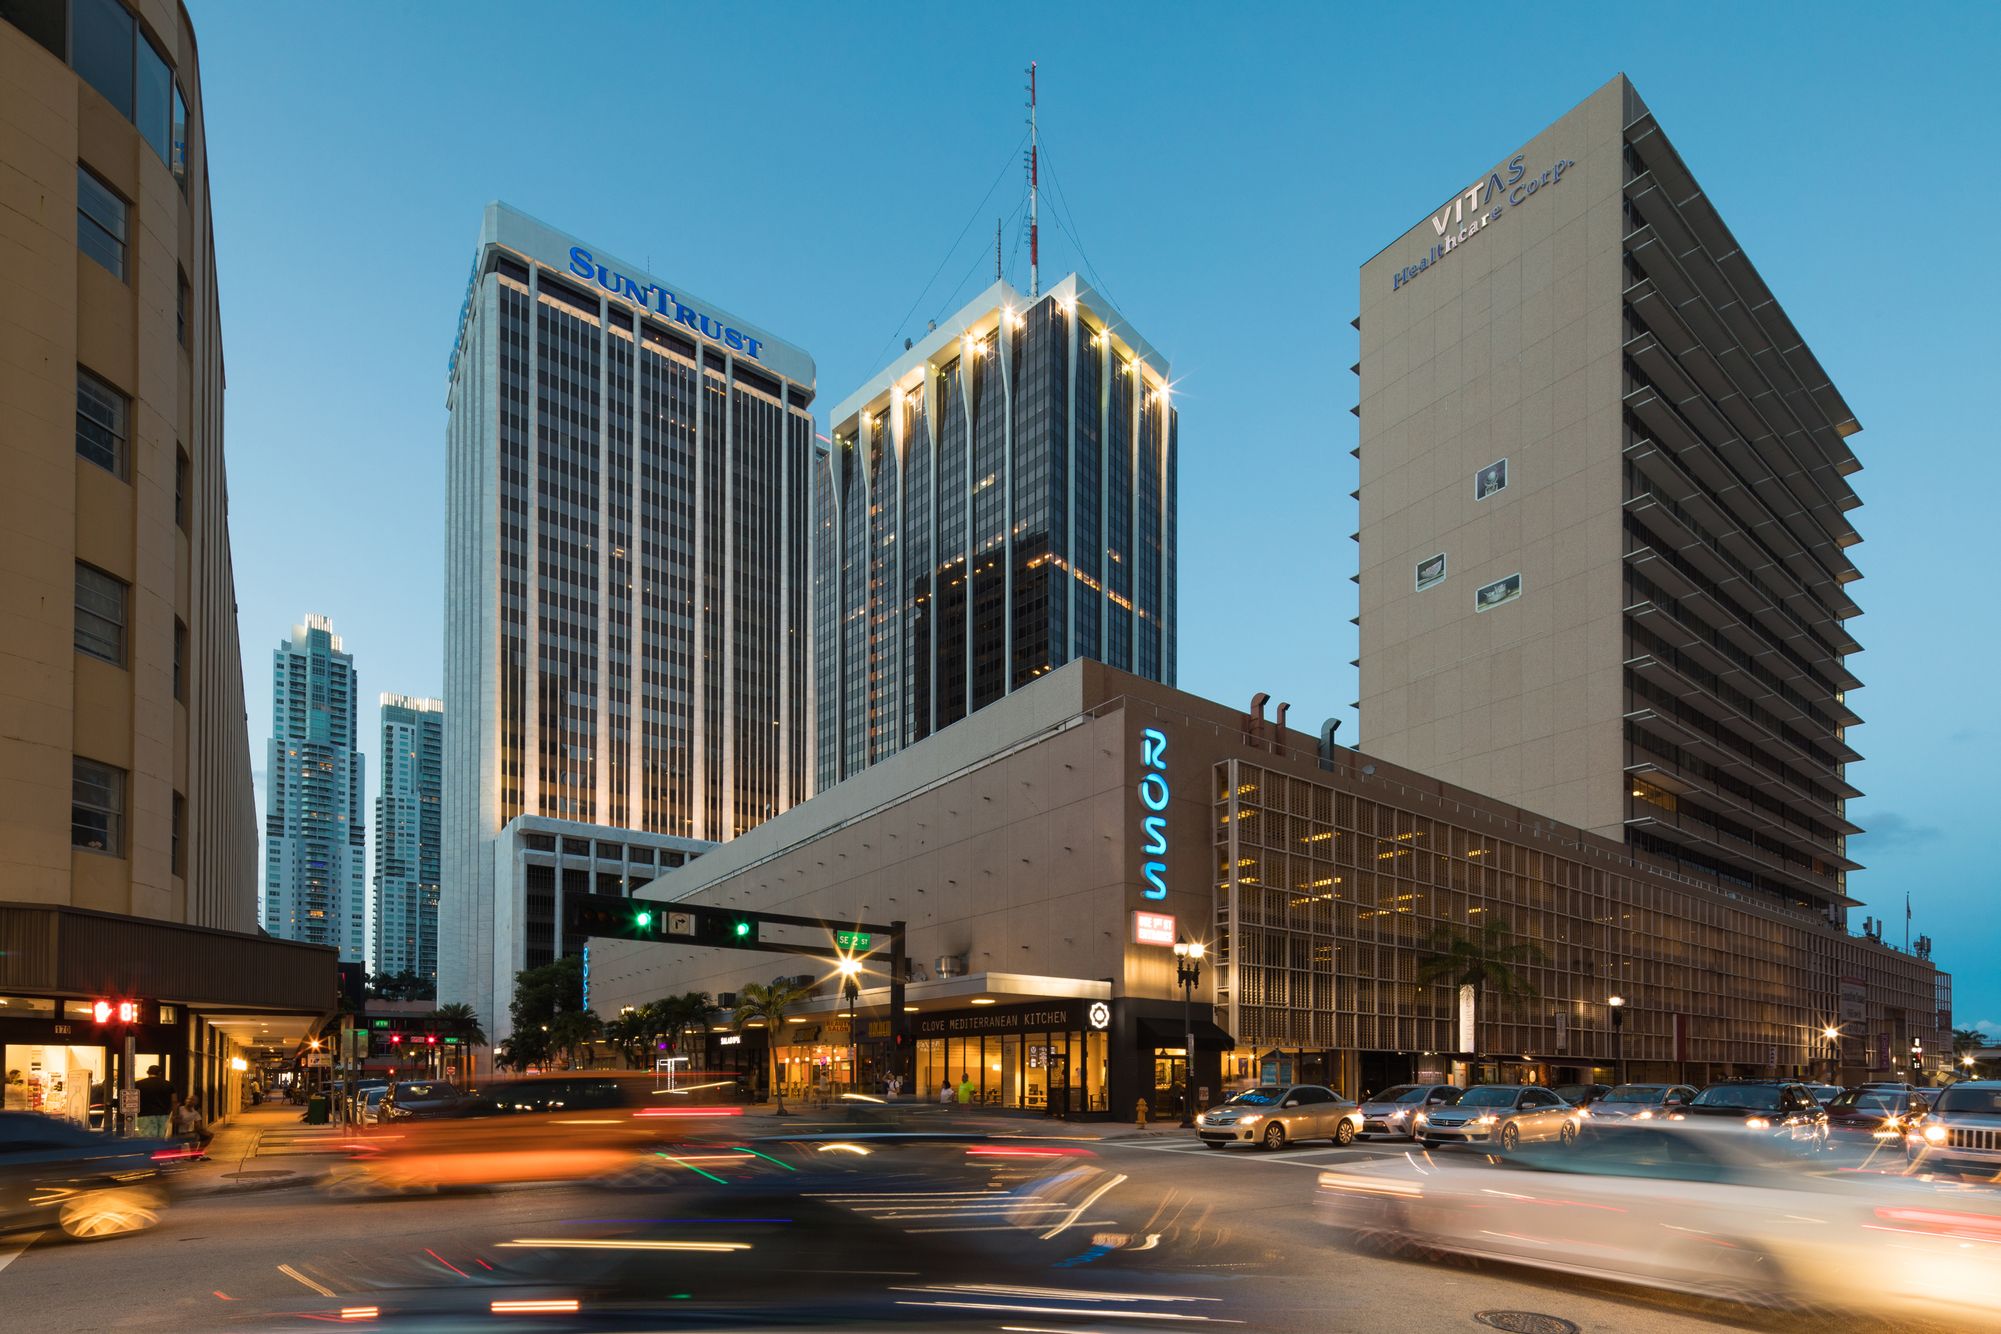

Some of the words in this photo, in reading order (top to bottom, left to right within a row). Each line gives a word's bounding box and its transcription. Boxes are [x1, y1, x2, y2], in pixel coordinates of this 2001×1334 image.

[1393, 204, 1503, 291] Healthcare
[1508, 158, 1576, 206] Corp.
[1432, 152, 1525, 236] VITAS
[1139, 728, 1170, 900] ROSS
[839, 935, 849, 945] SE
[852, 936, 858, 946] 2
[921, 1019, 945, 1032] CLOVE
[949, 1014, 1018, 1030] MEDITERRANEAN
[1024, 1011, 1067, 1025] KITCHEN
